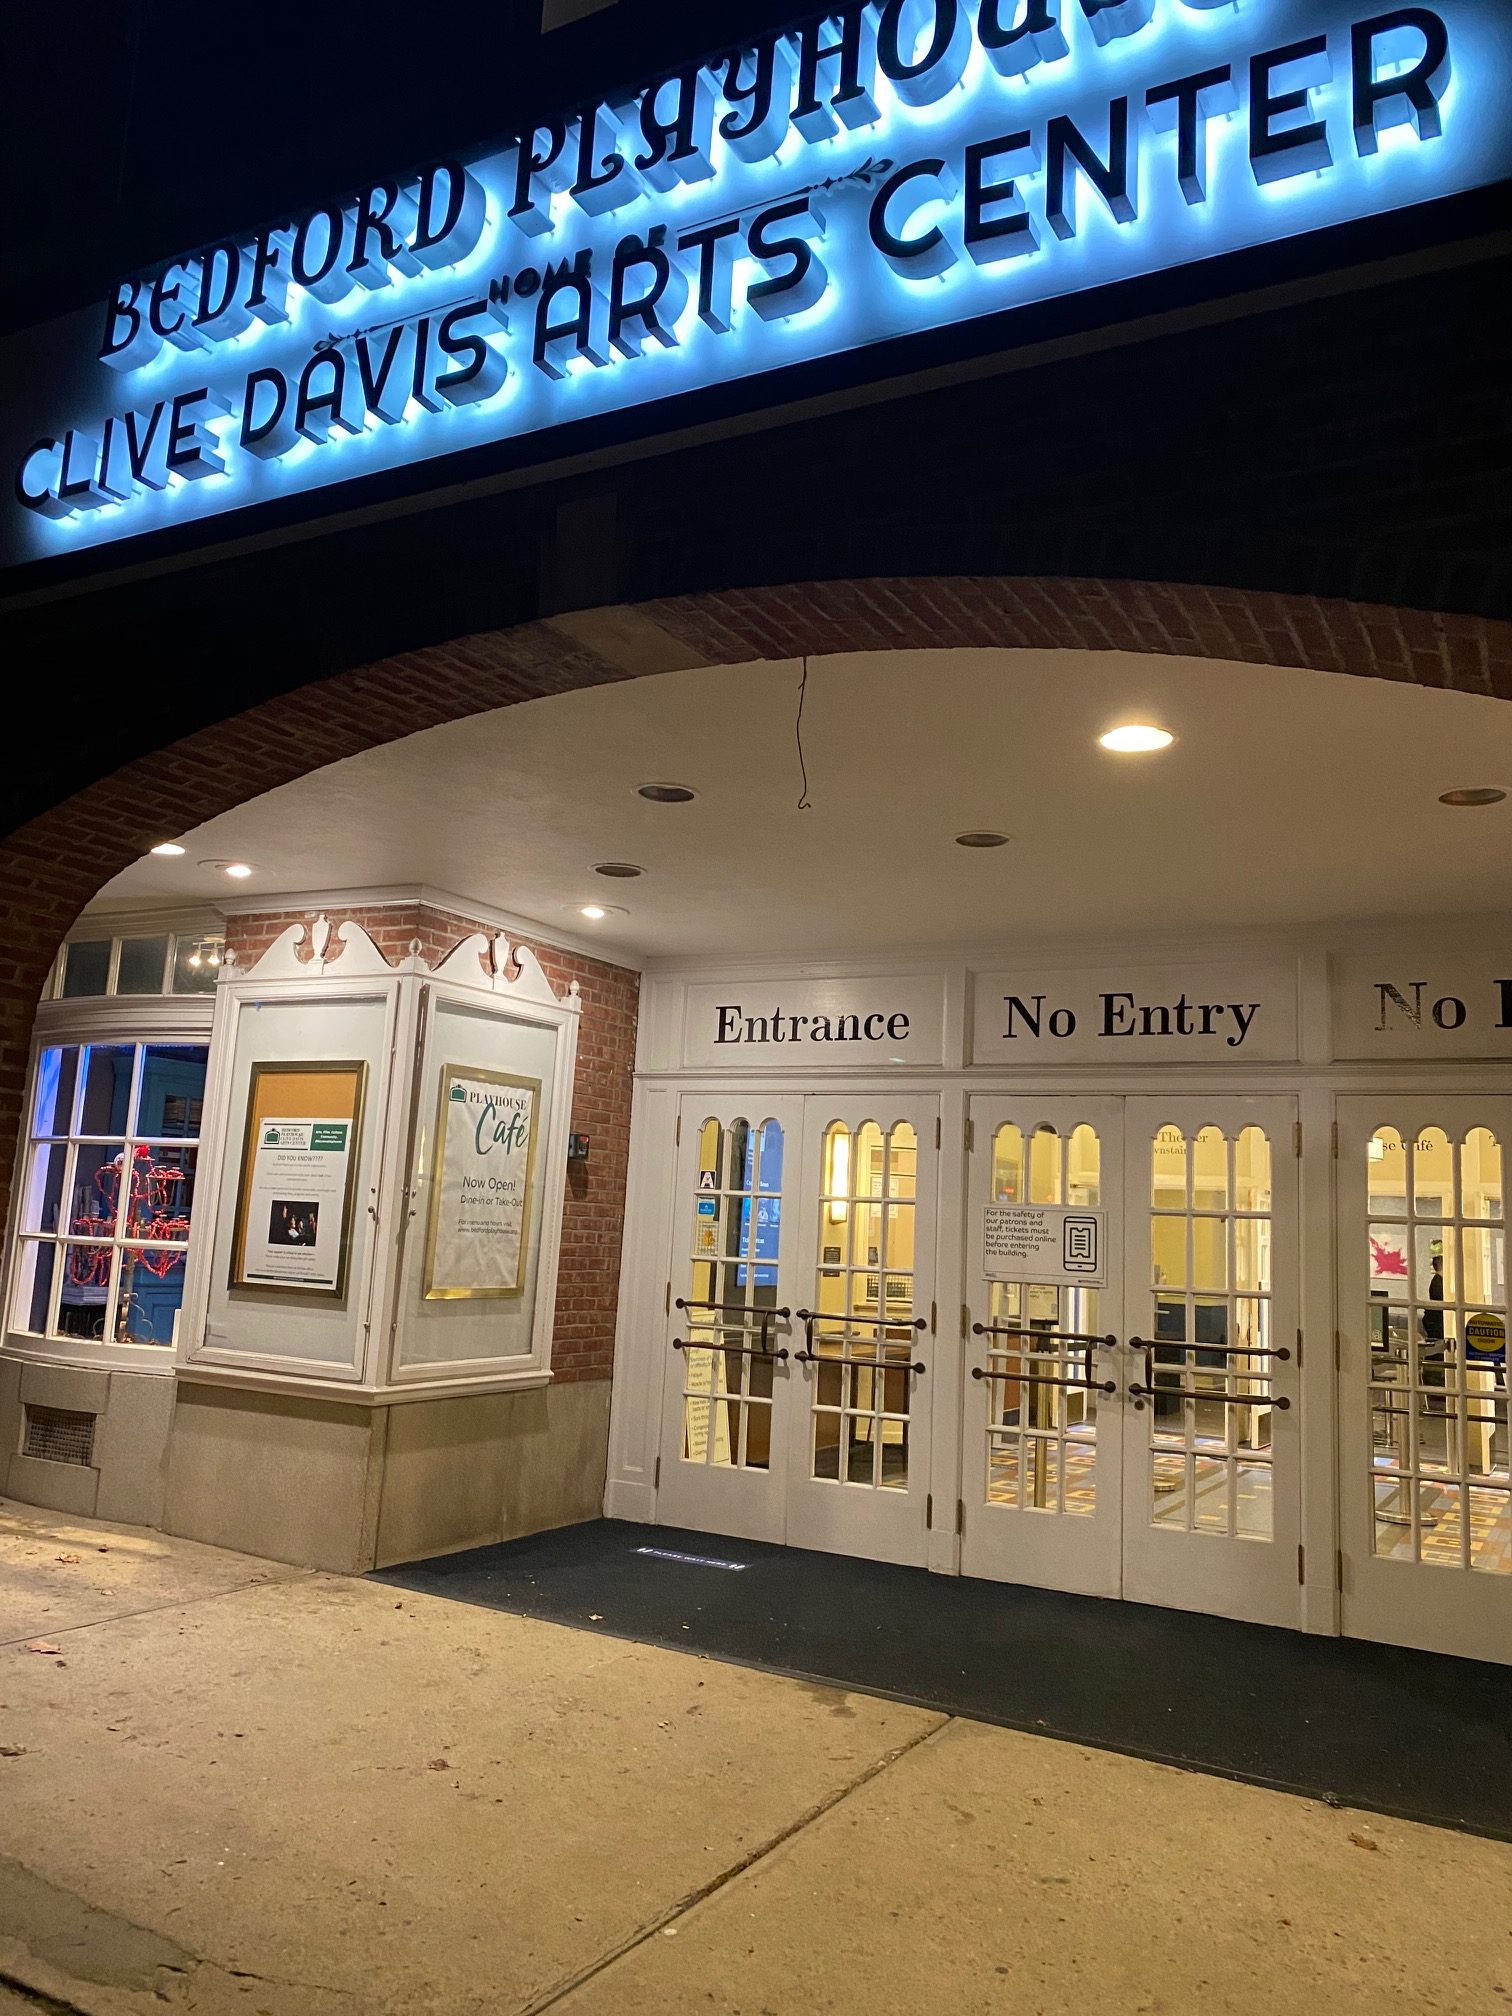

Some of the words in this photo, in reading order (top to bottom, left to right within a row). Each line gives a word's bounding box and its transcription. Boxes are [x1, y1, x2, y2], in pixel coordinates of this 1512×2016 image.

[100, 158, 468, 362] BEDFORD
[510, 0, 1215, 217] PLAYHOU
[14, 388, 208, 502] CLIVE
[240, 300, 488, 445] DAVIS
[533, 198, 812, 372] ARTS
[868, 8, 1448, 258] CENTER
[1374, 980, 1467, 1033] No
[713, 1004, 911, 1045] Entrance
[1003, 995, 1077, 1039] No
[1098, 992, 1261, 1047] Entry
[470, 1092, 527, 1111] PLAYHOUSE
[475, 1103, 528, 1155] Café
[1159, 1131, 1208, 1144] Theer
[1401, 1139, 1433, 1152] Cfé
[462, 1176, 486, 1188] Now
[488, 1178, 516, 1192] Open!
[460, 1195, 485, 1204] Dine-in
[495, 1197, 522, 1207] Take-Out
[1012, 1211, 1035, 1219] safety
[1000, 1220, 1027, 1228] patrons
[996, 1235, 1033, 1243] purchased
[1010, 1243, 1040, 1251] entering
[998, 1250, 1028, 1258] building.
[1468, 1327, 1505, 1338] CAUTION
